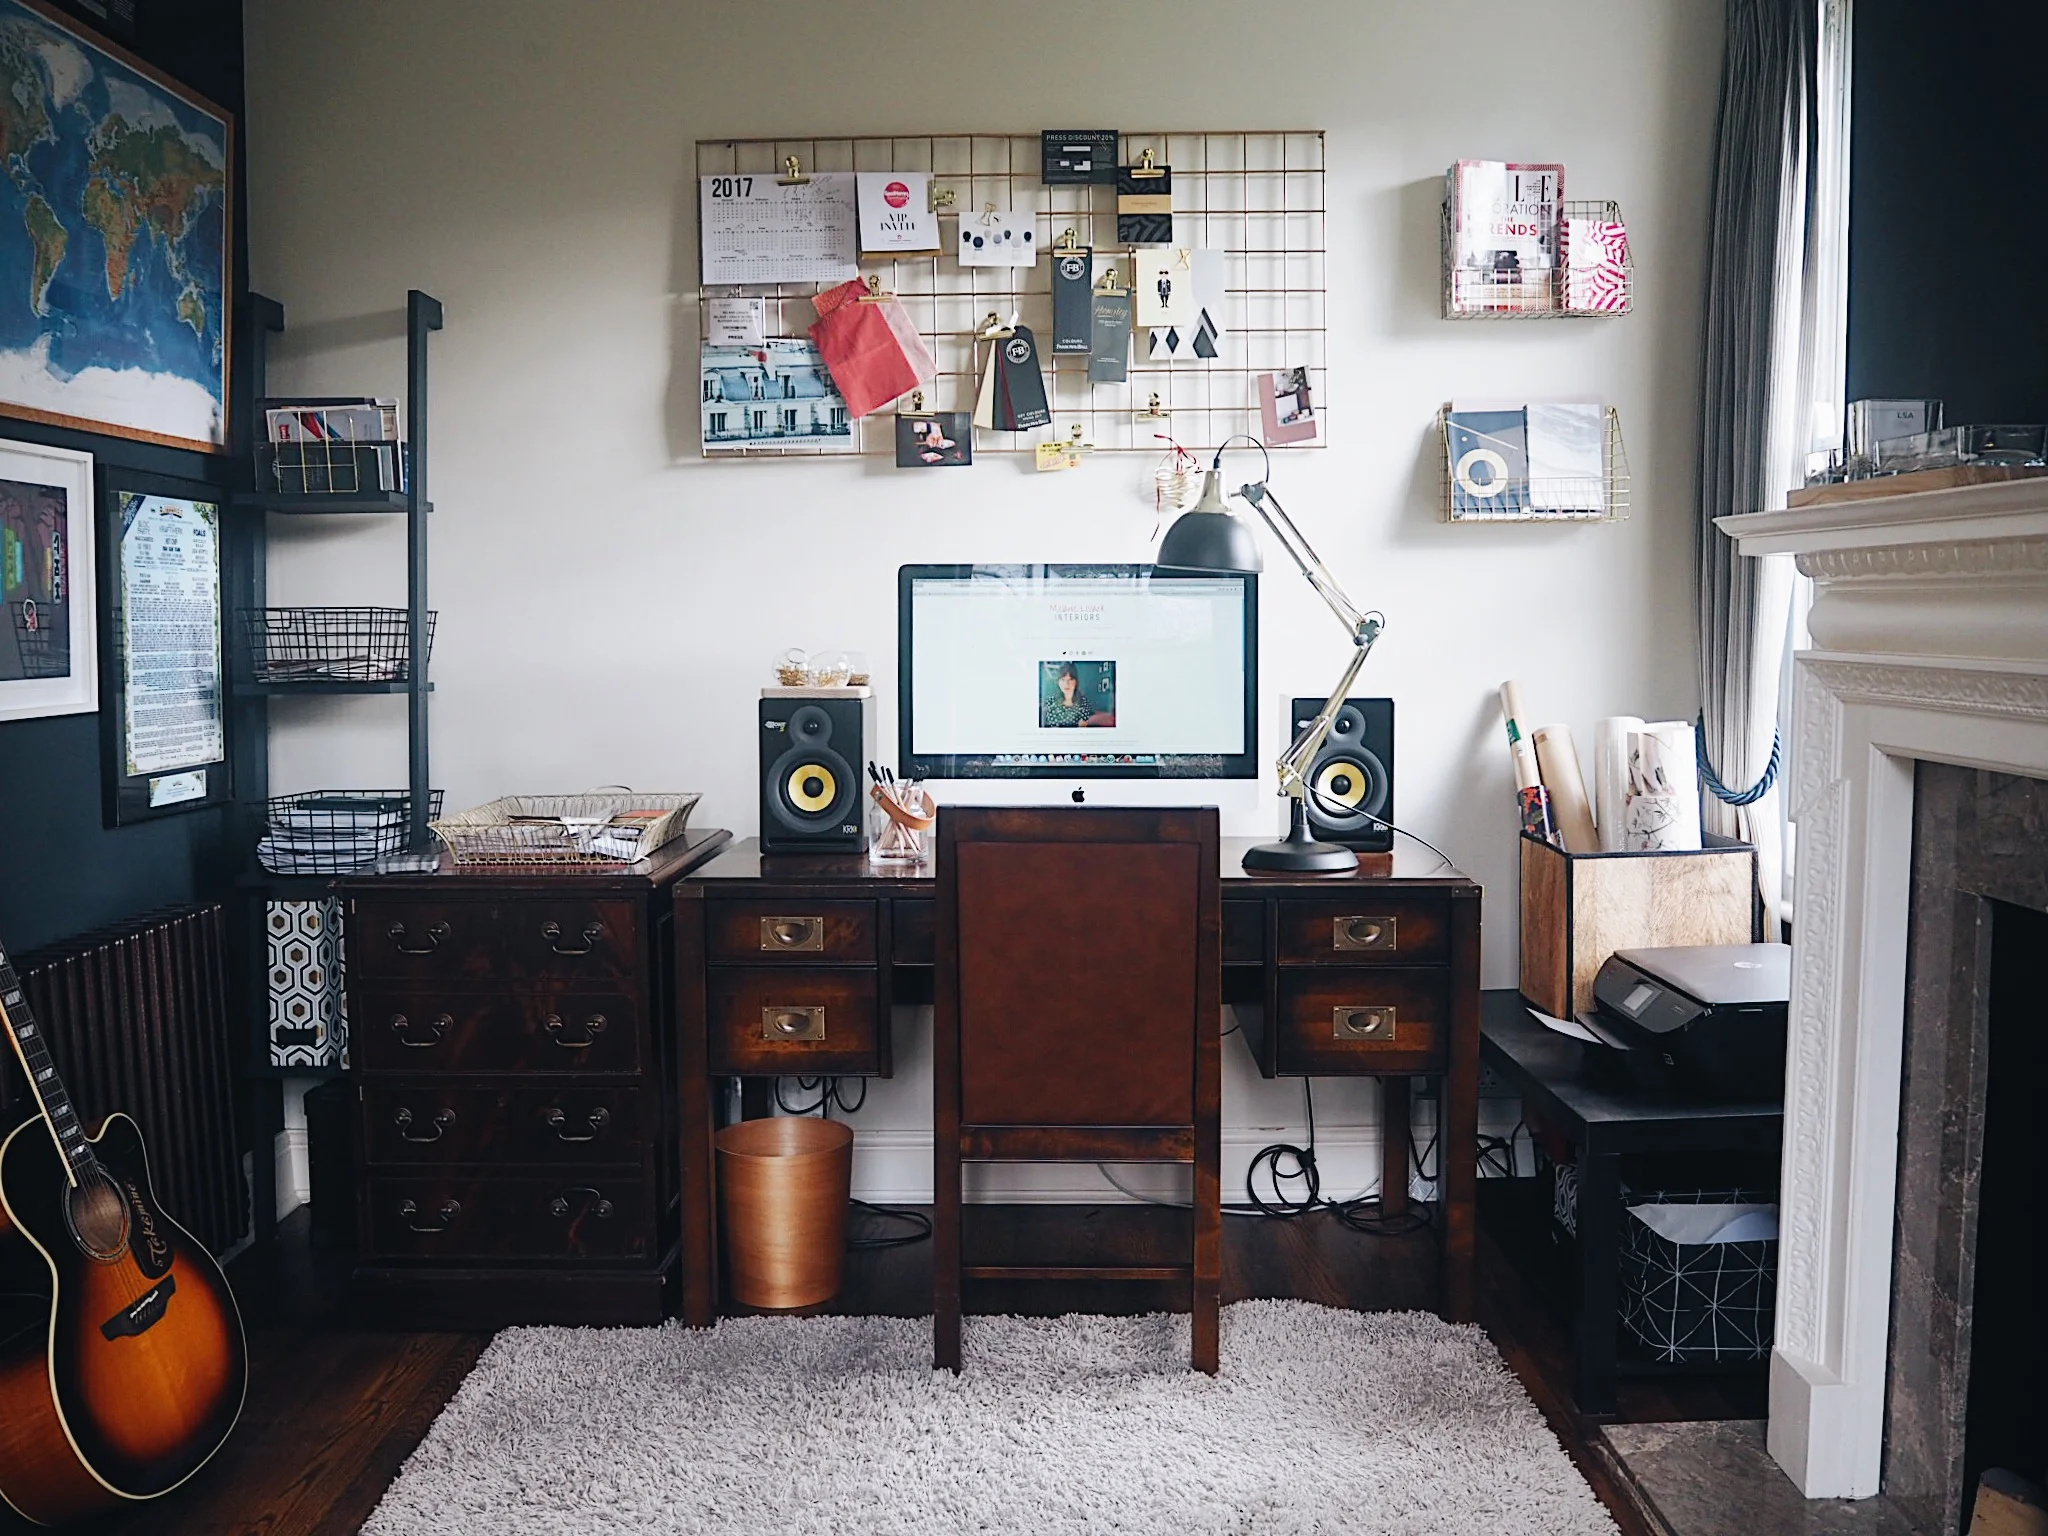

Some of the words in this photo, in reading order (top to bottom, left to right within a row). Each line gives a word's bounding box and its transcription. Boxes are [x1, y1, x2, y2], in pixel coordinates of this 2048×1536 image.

[711, 177, 753, 198] 2017
[889, 213, 907, 222] VIP
[1897, 411, 1914, 419] LSA
[1054, 613, 1100, 621] INTERIORS
